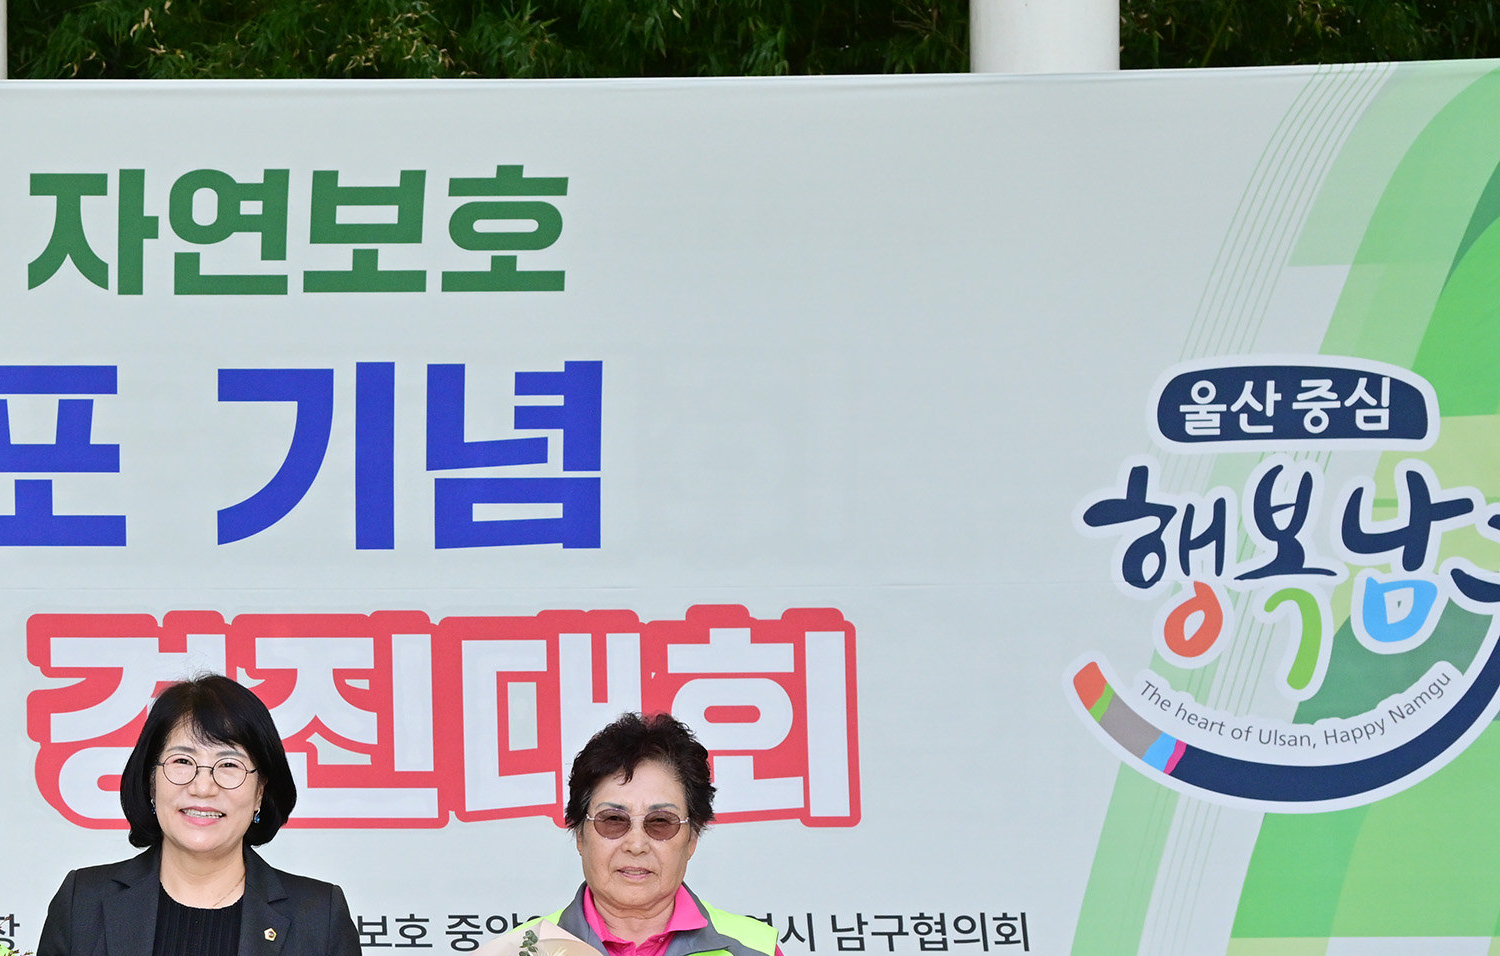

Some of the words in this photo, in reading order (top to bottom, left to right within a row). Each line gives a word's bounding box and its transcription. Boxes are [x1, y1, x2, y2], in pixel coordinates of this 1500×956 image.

[28, 164, 568, 295] 자연보호
[217, 360, 603, 549] 기념
[1180, 380, 1282, 435] 울산
[1292, 377, 1391, 433] 중심
[27, 604, 861, 828] 경진대회
[1141, 680, 1172, 712] The
[1175, 703, 1225, 736] heart
[1231, 726, 1253, 742] of
[1259, 728, 1317, 749] Ulsan,
[1324, 717, 1385, 745] Happy
[1388, 671, 1452, 723] Namgu
[357, 914, 433, 948] 보호
[830, 912, 1030, 952] 남구협의회
